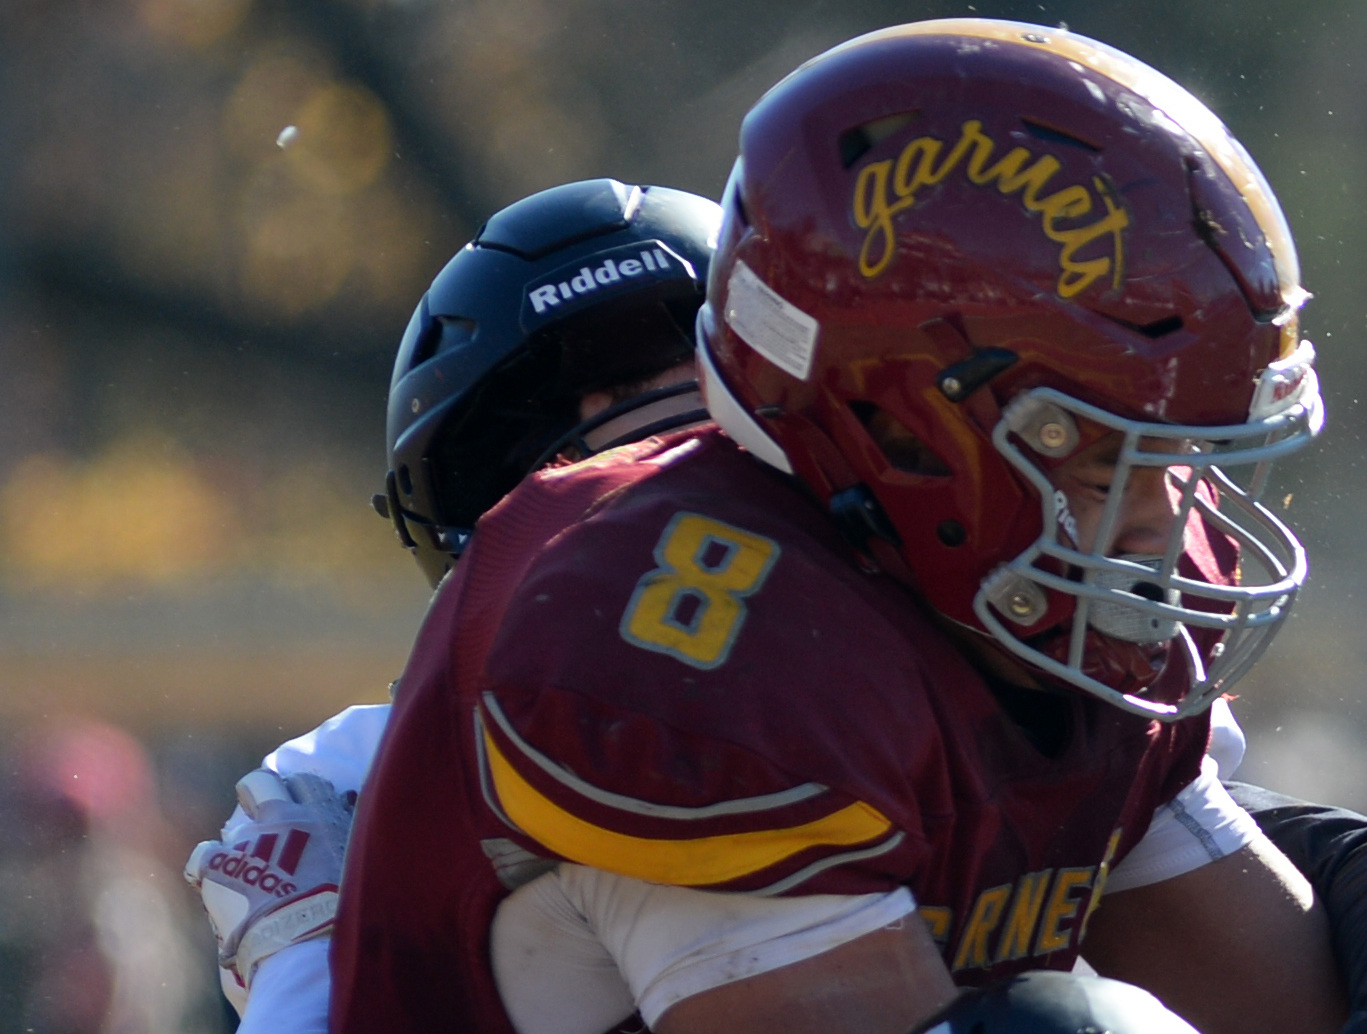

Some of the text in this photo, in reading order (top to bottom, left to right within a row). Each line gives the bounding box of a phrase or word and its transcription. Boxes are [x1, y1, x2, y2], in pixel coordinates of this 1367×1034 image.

[853, 119, 1129, 298] garnets
[529, 249, 670, 313] Riddell
[619, 512, 782, 671] 8
[208, 852, 297, 898] adidas
